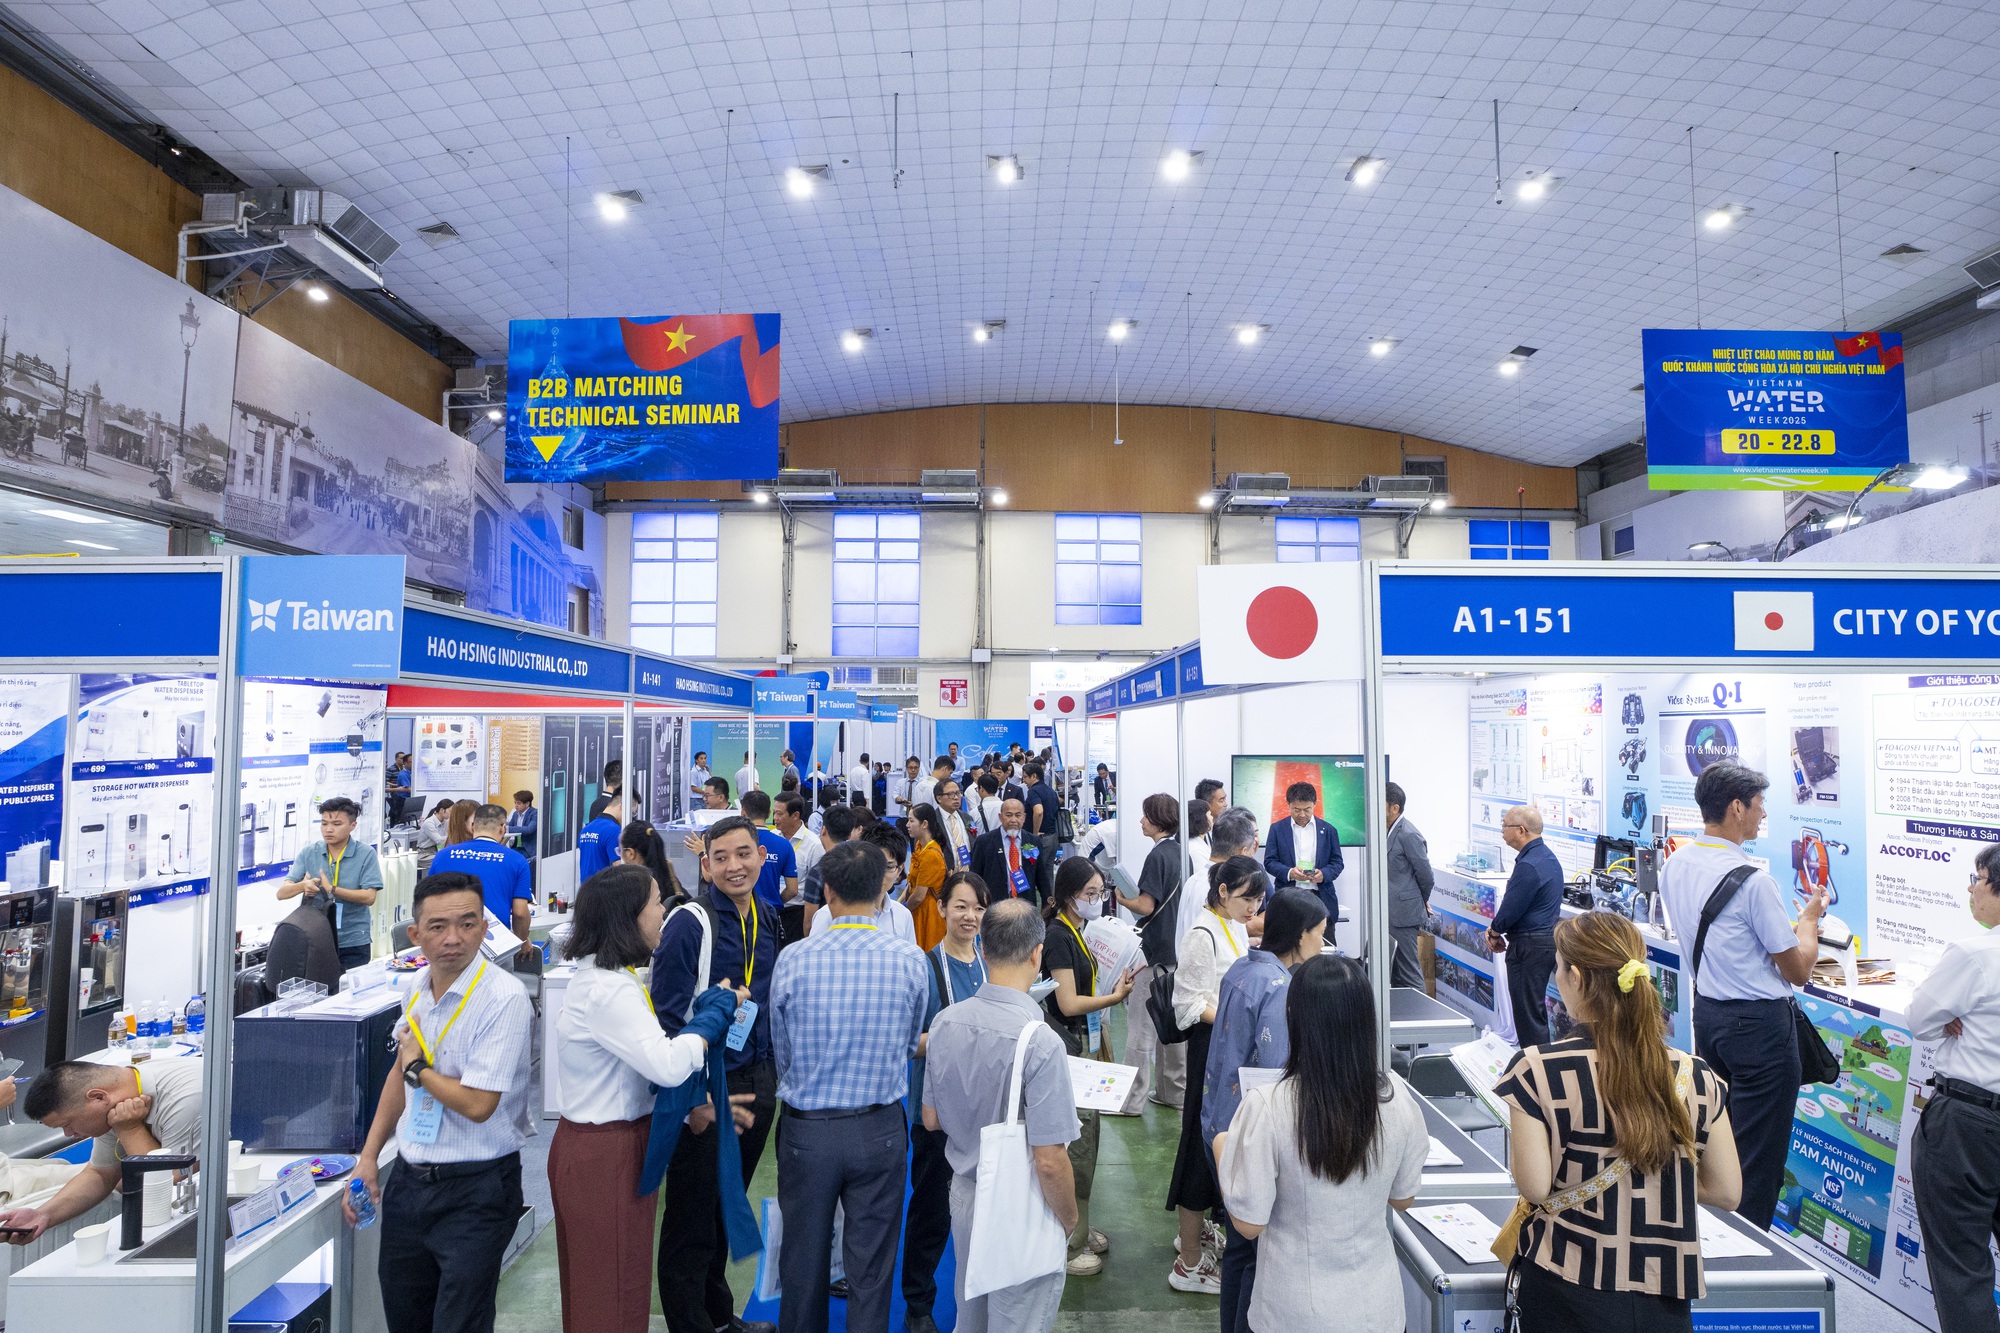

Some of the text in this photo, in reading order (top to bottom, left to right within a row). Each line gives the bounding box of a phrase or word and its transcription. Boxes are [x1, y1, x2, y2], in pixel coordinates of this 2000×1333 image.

[1712, 348, 1834, 361] NHIỆT LIỆT CHÀO MỪNG 80 NĂM
[1662, 360, 1886, 376] QUỐC KHÁNH NƯỚC CỘNG HÒA XÃ HỘI CHỦ NGHĨA VIỆT NAM
[528, 375, 682, 398] B2B MATCHING
[1748, 379, 1803, 387] VIETNAM
[1727, 390, 1825, 412] WATER
[527, 404, 740, 427] TECHNICAL SEMINAR
[1748, 416, 1806, 424] WEEK 2025
[1738, 434, 1760, 450] 20
[1782, 434, 1821, 451] 22.8
[1733, 466, 1829, 474] www.vietnamwaterweek.vn
[287, 600, 394, 631] Taiwan
[1453, 606, 1572, 634] A1-151
[1832, 608, 1905, 636] CITY
[1916, 609, 1959, 636] OF
[428, 636, 588, 677] HAO HSING INDUSTRIAL CO., LTD
[642, 671, 661, 686] A1-141
[676, 678, 686, 690] HAO
[686, 678, 699, 692] HSING
[1808, 680, 1832, 689] product
[1926, 674, 1992, 686] Giới thiệu công
[769, 692, 805, 702] Taiwan
[1667, 696, 1684, 705] Video
[1686, 695, 1709, 705] System
[829, 701, 855, 709] Taiwan
[1698, 746, 1703, 755] &
[1705, 745, 1760, 755] INNOVAN
[1985, 747, 1997, 755] MT
[80, 765, 106, 773] HM-699
[20, 784, 54, 793] DISPENSER
[92, 784, 122, 792] STORAGE
[160, 780, 189, 788] DISPENSER
[1912, 778, 1931, 786] Thành
[1933, 779, 1941, 787] lập
[1955, 780, 1971, 788] đoàn
[4, 794, 54, 805] PUBLIC SPACES
[1912, 796, 1931, 804] Thành
[1944, 798, 1960, 807] công
[1961, 800, 1967, 808] ty
[1981, 802, 1999, 810] Aqua
[1912, 805, 1931, 813] Thành
[1944, 808, 1960, 817] công
[1913, 823, 1998, 840] Thương Hiệu & Sản
[1880, 844, 1951, 863] ACCOFLOC
[1883, 875, 1896, 883] Dạng
[1877, 925, 1894, 933] Polyme
[1883, 919, 1896, 927] Dạng
[1909, 925, 1926, 934] tương
[1796, 1127, 1803, 1136] LÝ
[1804, 1131, 1823, 1146] NƯỚC
[1824, 1143, 1842, 1156] SẠCH
[1861, 1160, 1876, 1174] TIẾN
[1793, 1140, 1864, 1186] PAM ANION
[1826, 1179, 1840, 1194] NSF
[1898, 1175, 1911, 1185] QUY
[1812, 1193, 1871, 1230] ACH PAM ANION
[1820, 1246, 1877, 1285] TOAGOSEI VIETNAM
